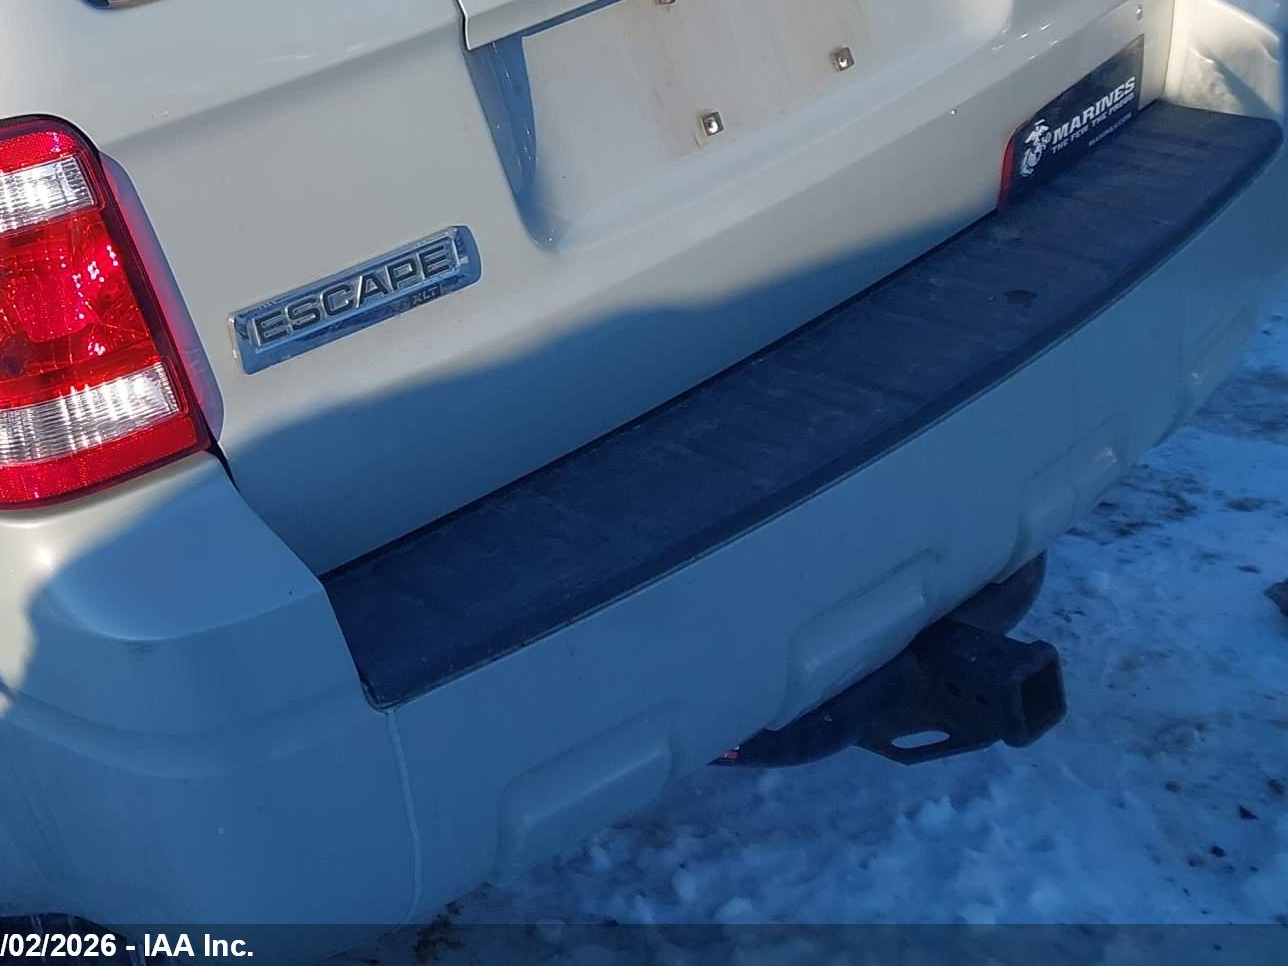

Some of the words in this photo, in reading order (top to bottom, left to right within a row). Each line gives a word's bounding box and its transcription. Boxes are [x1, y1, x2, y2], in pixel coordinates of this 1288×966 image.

[1052, 76, 1136, 145] MARINES
[1052, 138, 1070, 155] THE
[1091, 111, 1108, 128] THE
[251, 237, 454, 347] ESCAPE
[412, 285, 440, 305] XLT
